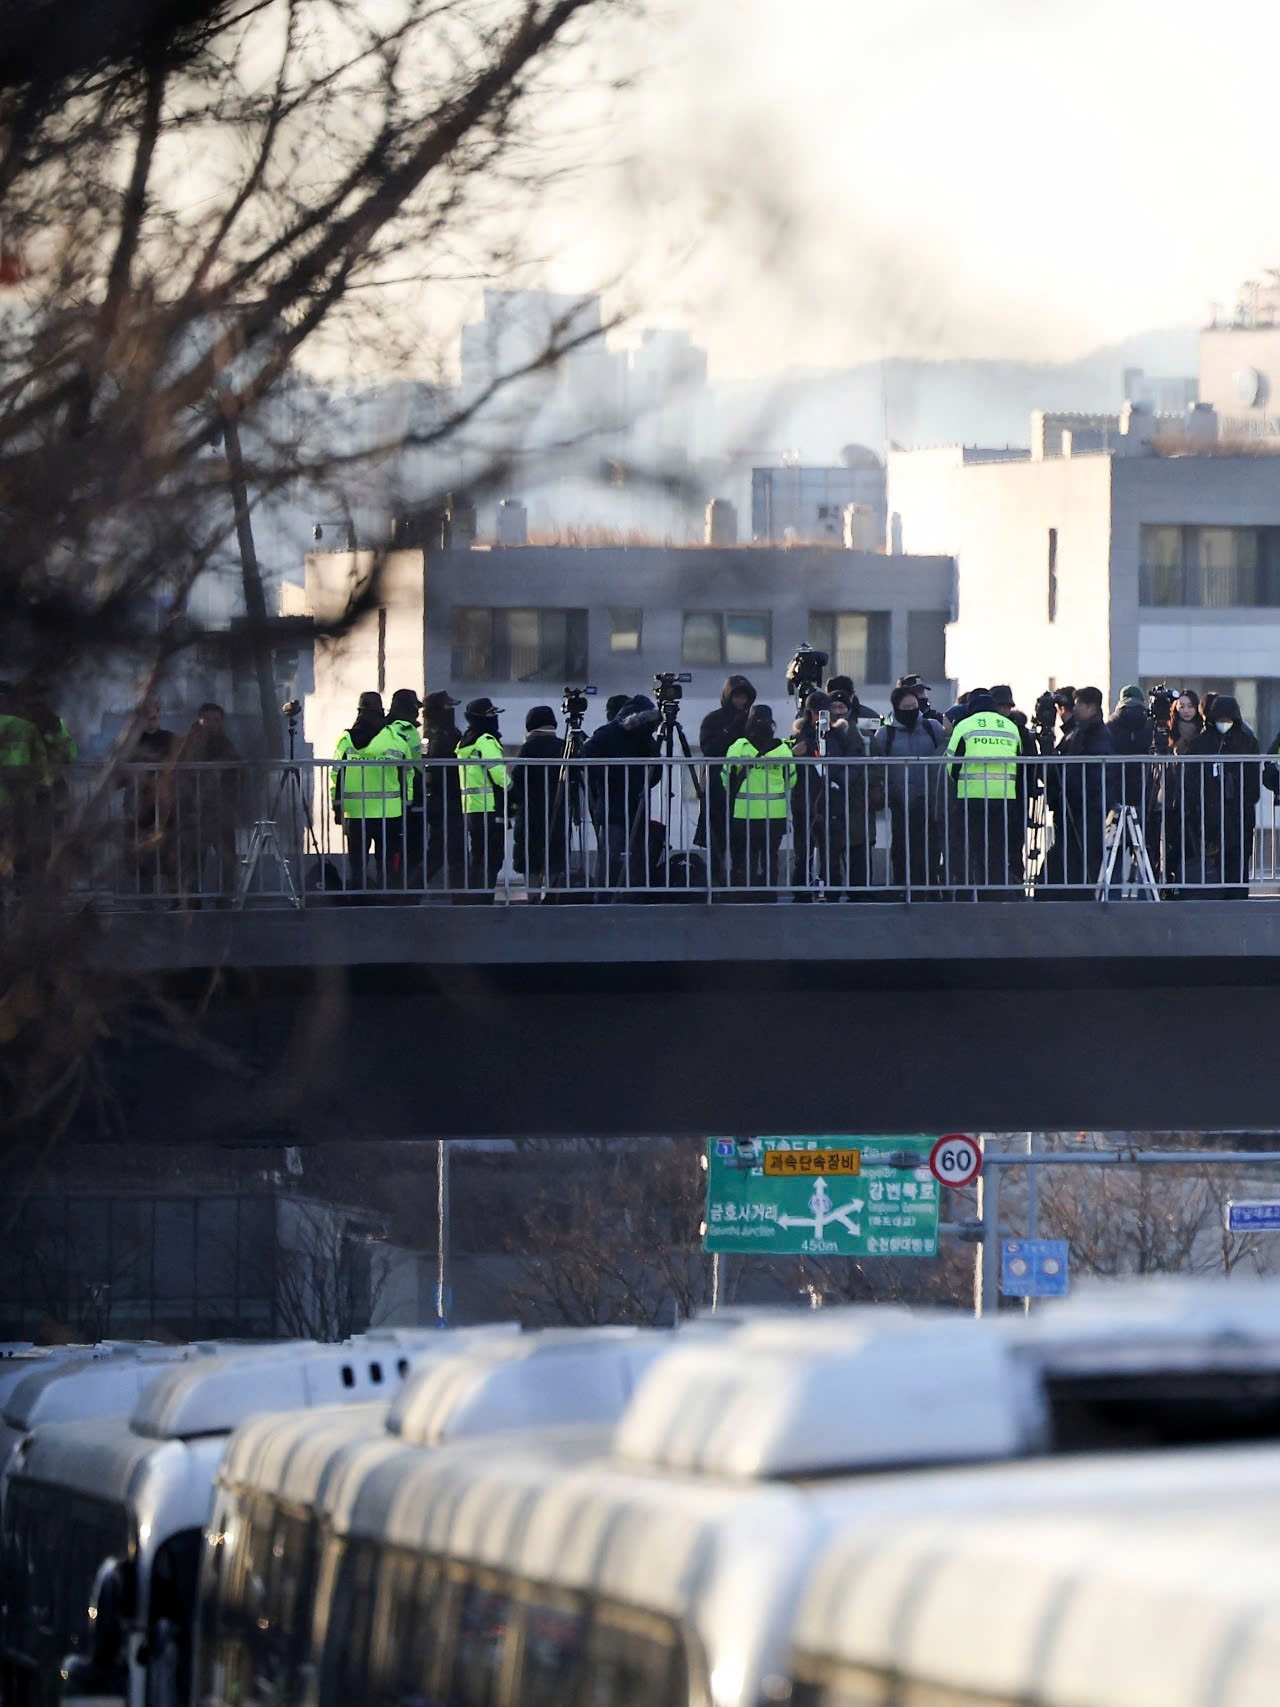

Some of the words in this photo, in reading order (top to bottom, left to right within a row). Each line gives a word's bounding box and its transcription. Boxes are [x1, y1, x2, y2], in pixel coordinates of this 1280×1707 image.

[974, 738, 1012, 746] POLICE
[770, 1154, 854, 1171] 과속단속장비
[942, 1150, 971, 1171] 60
[801, 1240, 838, 1251] 450m
